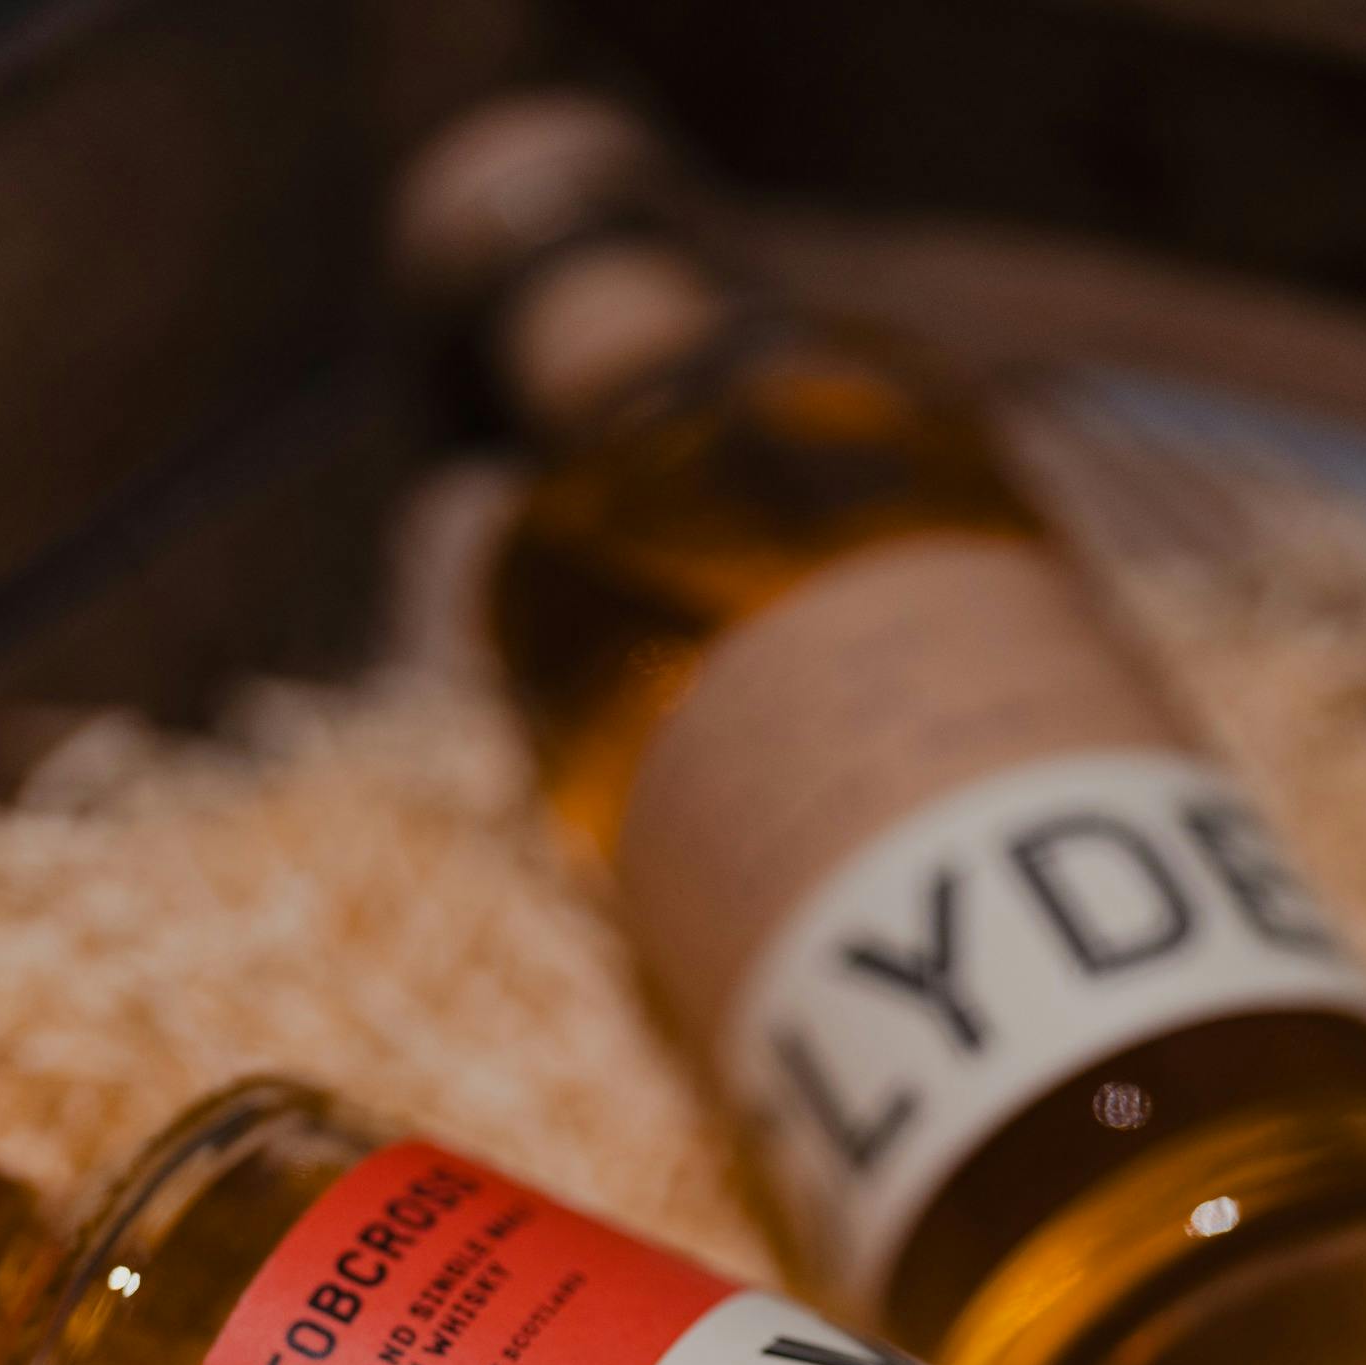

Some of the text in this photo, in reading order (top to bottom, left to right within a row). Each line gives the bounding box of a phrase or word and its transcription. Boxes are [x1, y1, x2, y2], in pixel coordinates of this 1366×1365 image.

[763, 795, 1347, 1172] LYDE
[409, 1239, 489, 1319] SINGLE
[429, 1263, 508, 1357] WHISKY
[506, 1272, 586, 1363] SCOTLAND
